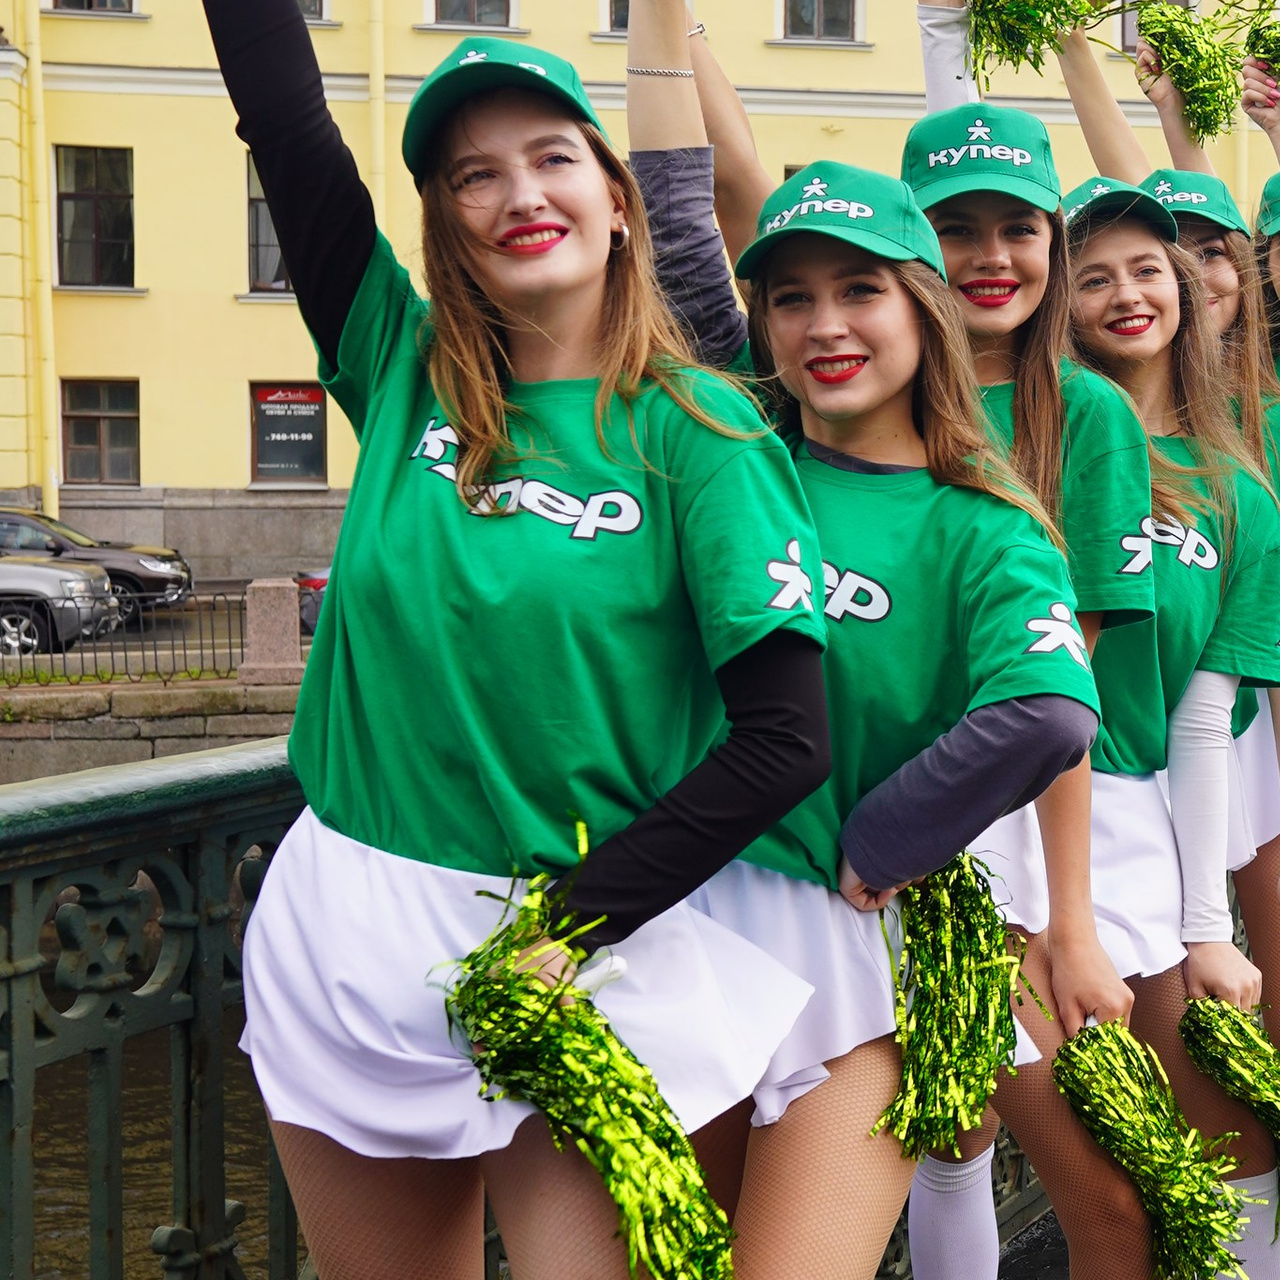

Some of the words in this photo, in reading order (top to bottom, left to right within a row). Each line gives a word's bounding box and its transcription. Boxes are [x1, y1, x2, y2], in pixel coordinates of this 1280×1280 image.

[928, 144, 1032, 168] купер
[1157, 192, 1208, 204] пер
[766, 199, 874, 234] купер
